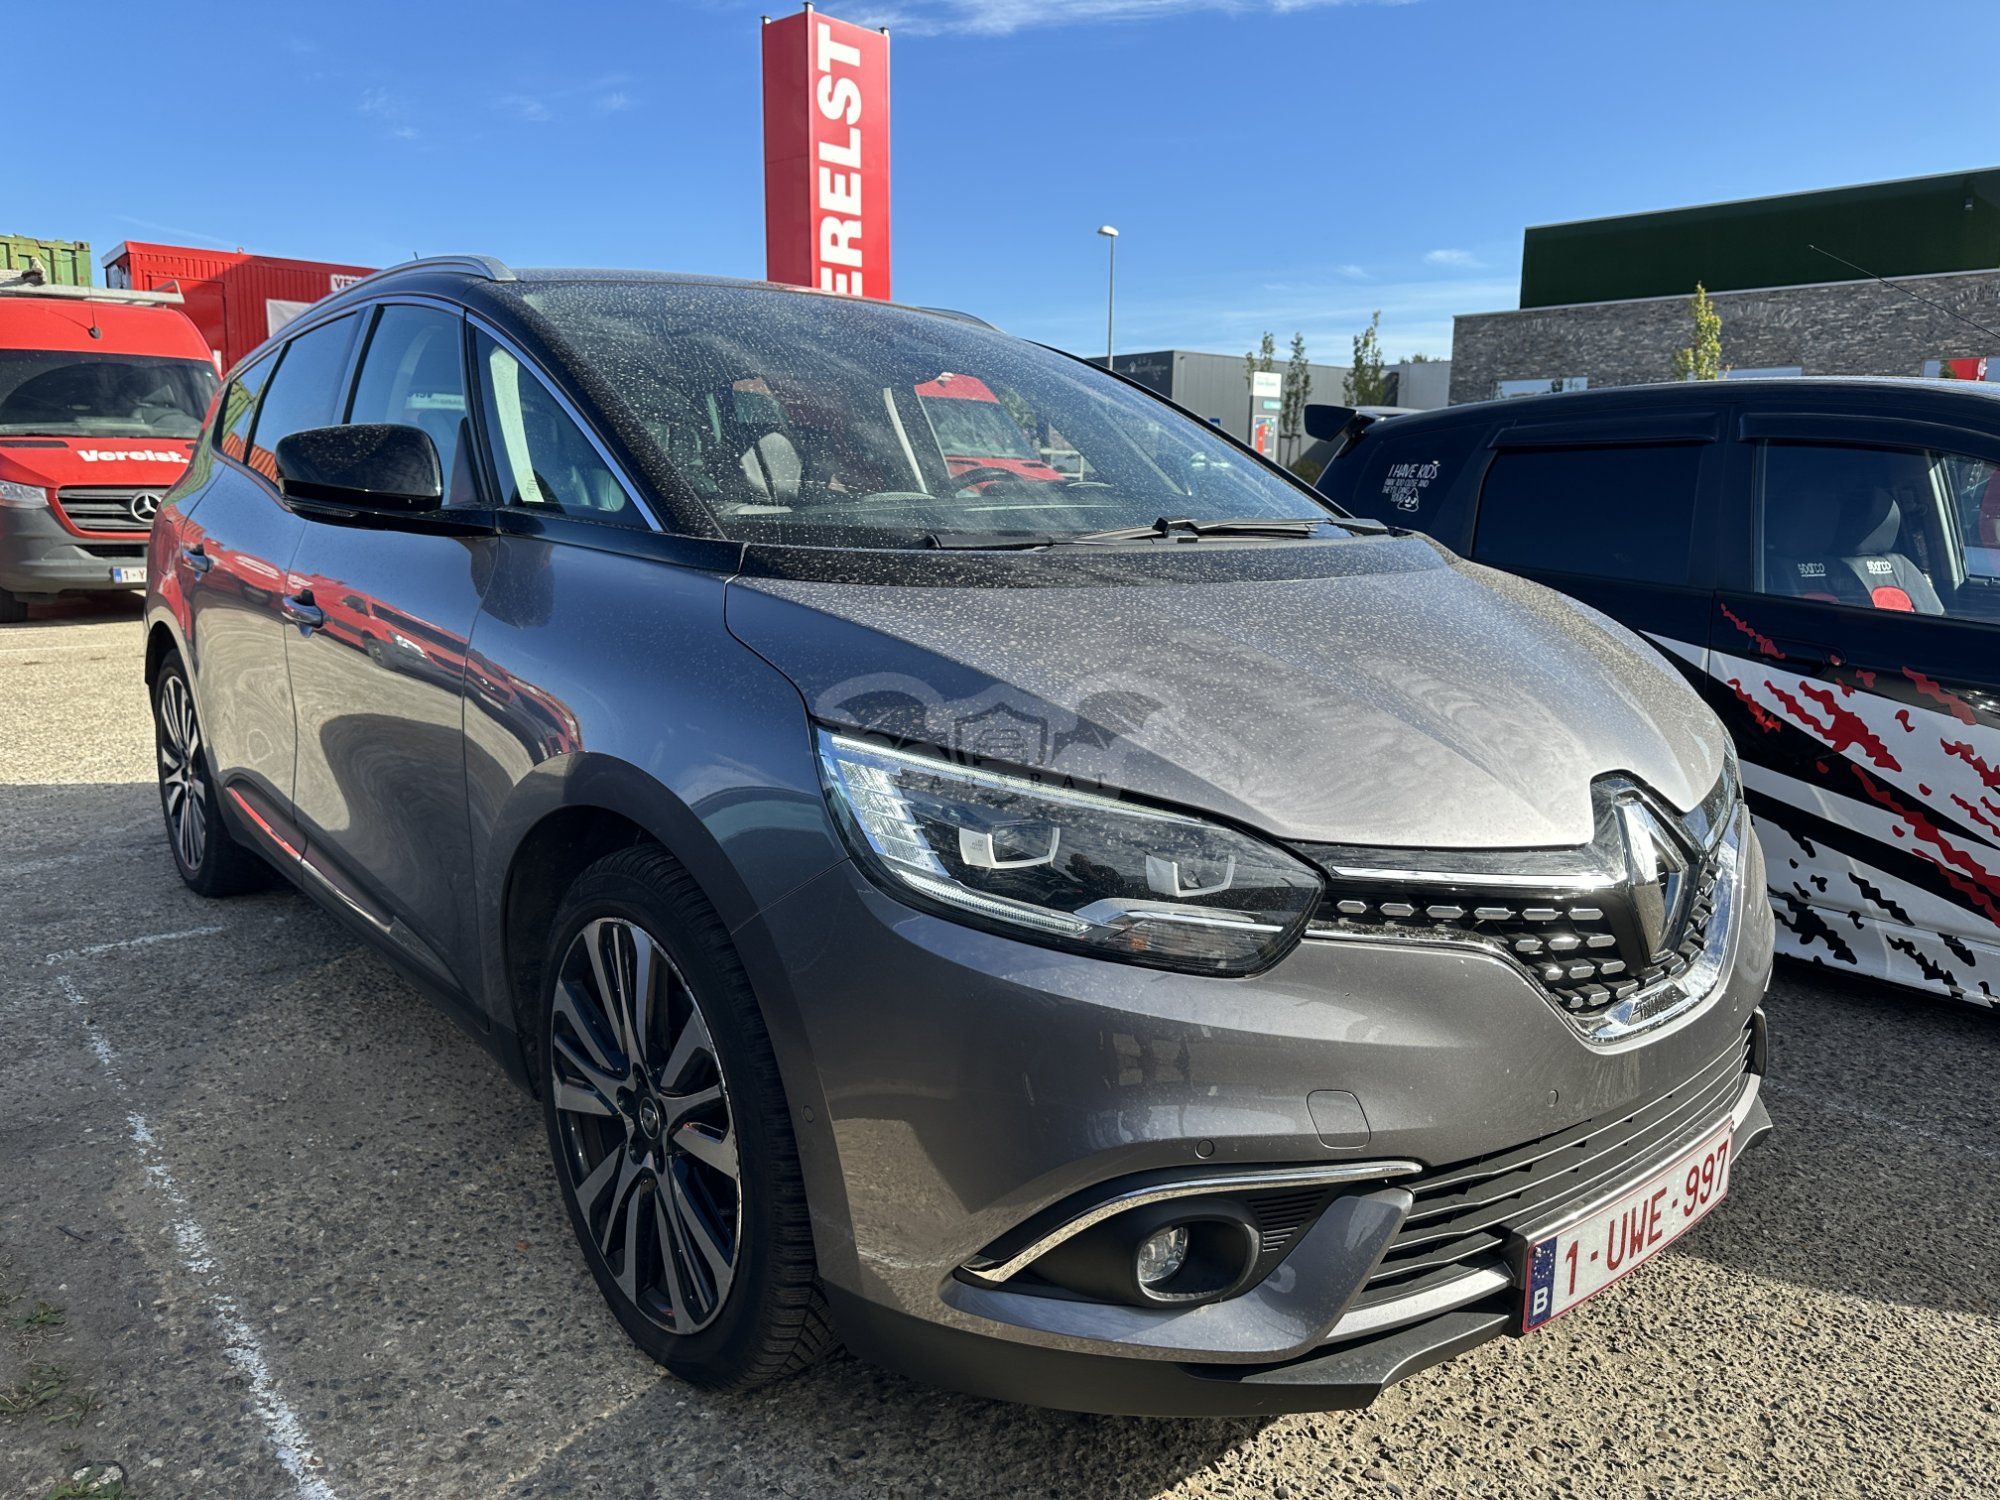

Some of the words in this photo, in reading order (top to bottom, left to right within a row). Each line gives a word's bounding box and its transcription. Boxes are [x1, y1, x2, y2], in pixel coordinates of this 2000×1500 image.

[1392, 463, 1419, 478] HAVE
[1416, 463, 1441, 479] KIDS
[1565, 1139, 1729, 1296] 1-UWE-997
[1532, 1286, 1549, 1316] B
